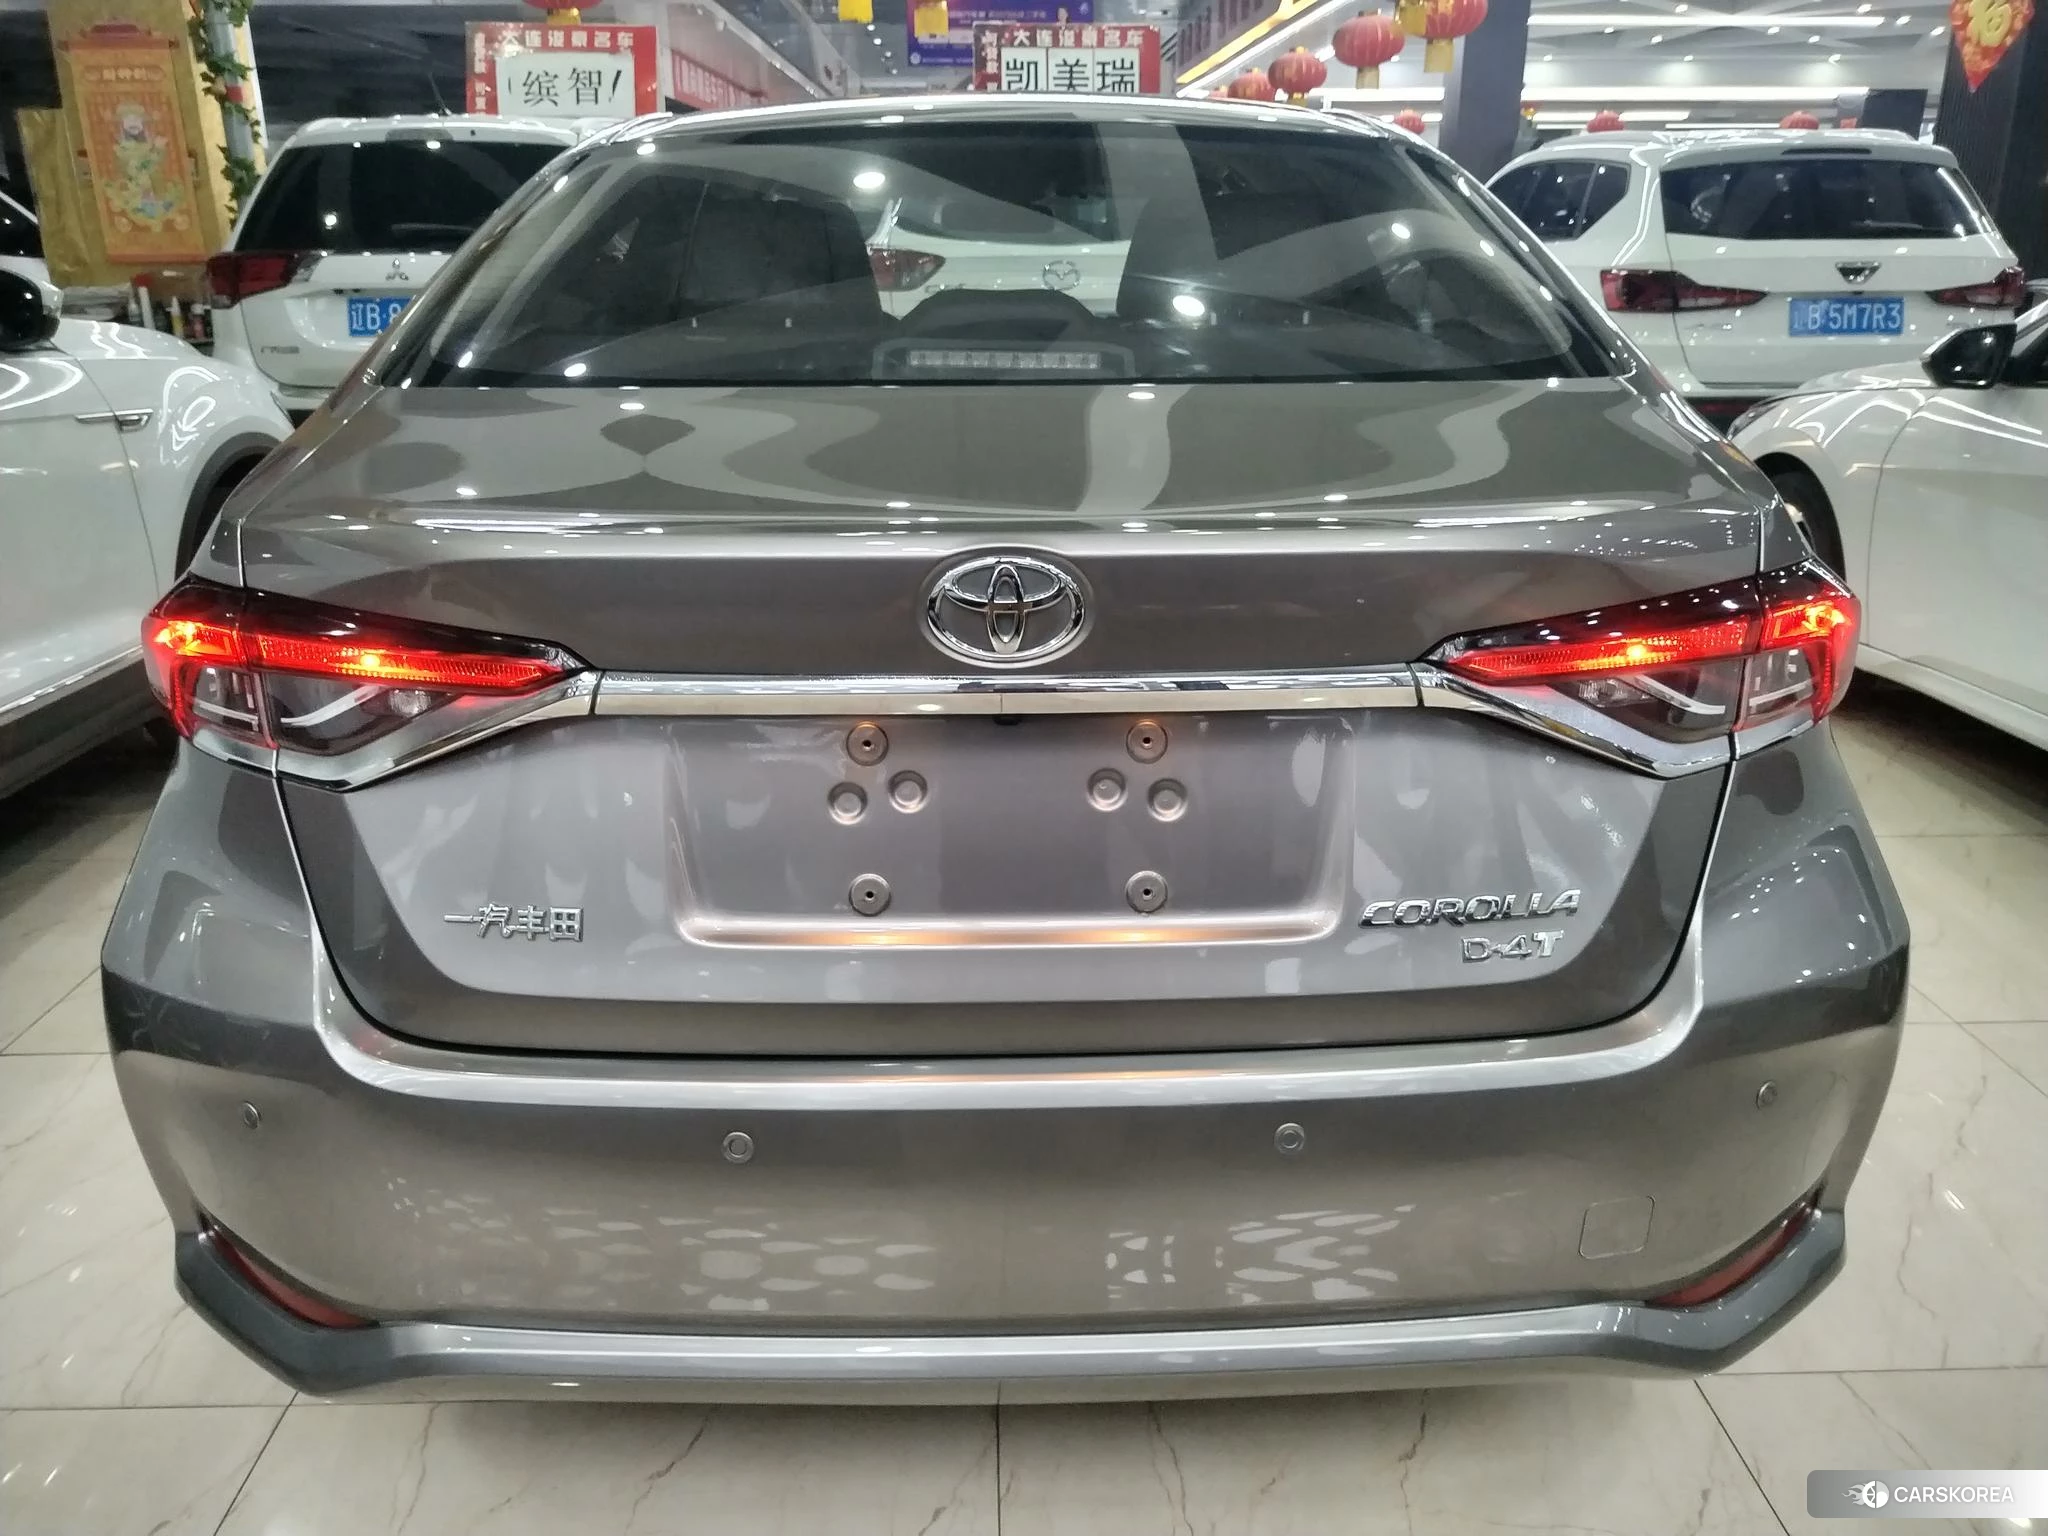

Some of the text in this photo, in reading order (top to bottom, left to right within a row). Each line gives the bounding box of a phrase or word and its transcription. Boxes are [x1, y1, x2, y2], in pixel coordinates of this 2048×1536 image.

[1005, 58, 1135, 93] 凯美瑞
[444, 903, 583, 942] 一汽丰田
[1359, 889, 1581, 928] COROLLA
[1461, 930, 1565, 963] D-4T
